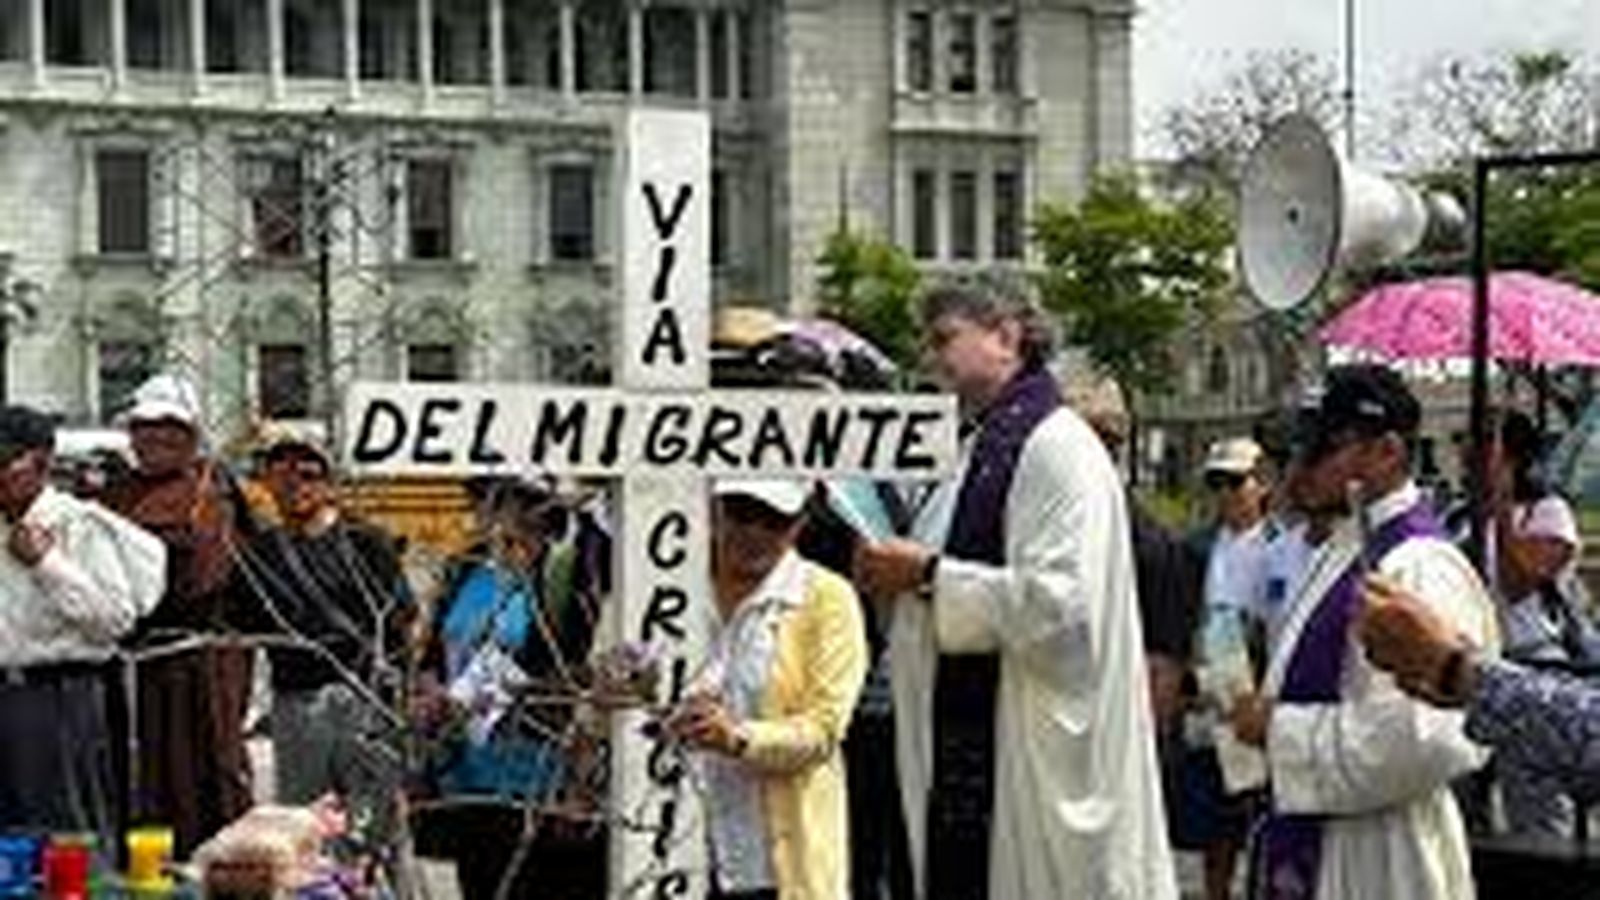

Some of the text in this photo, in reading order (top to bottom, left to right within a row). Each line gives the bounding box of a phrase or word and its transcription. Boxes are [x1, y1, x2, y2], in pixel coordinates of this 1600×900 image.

[641, 181, 694, 366] VIA
[352, 398, 942, 471] DEL MIGRANTE
